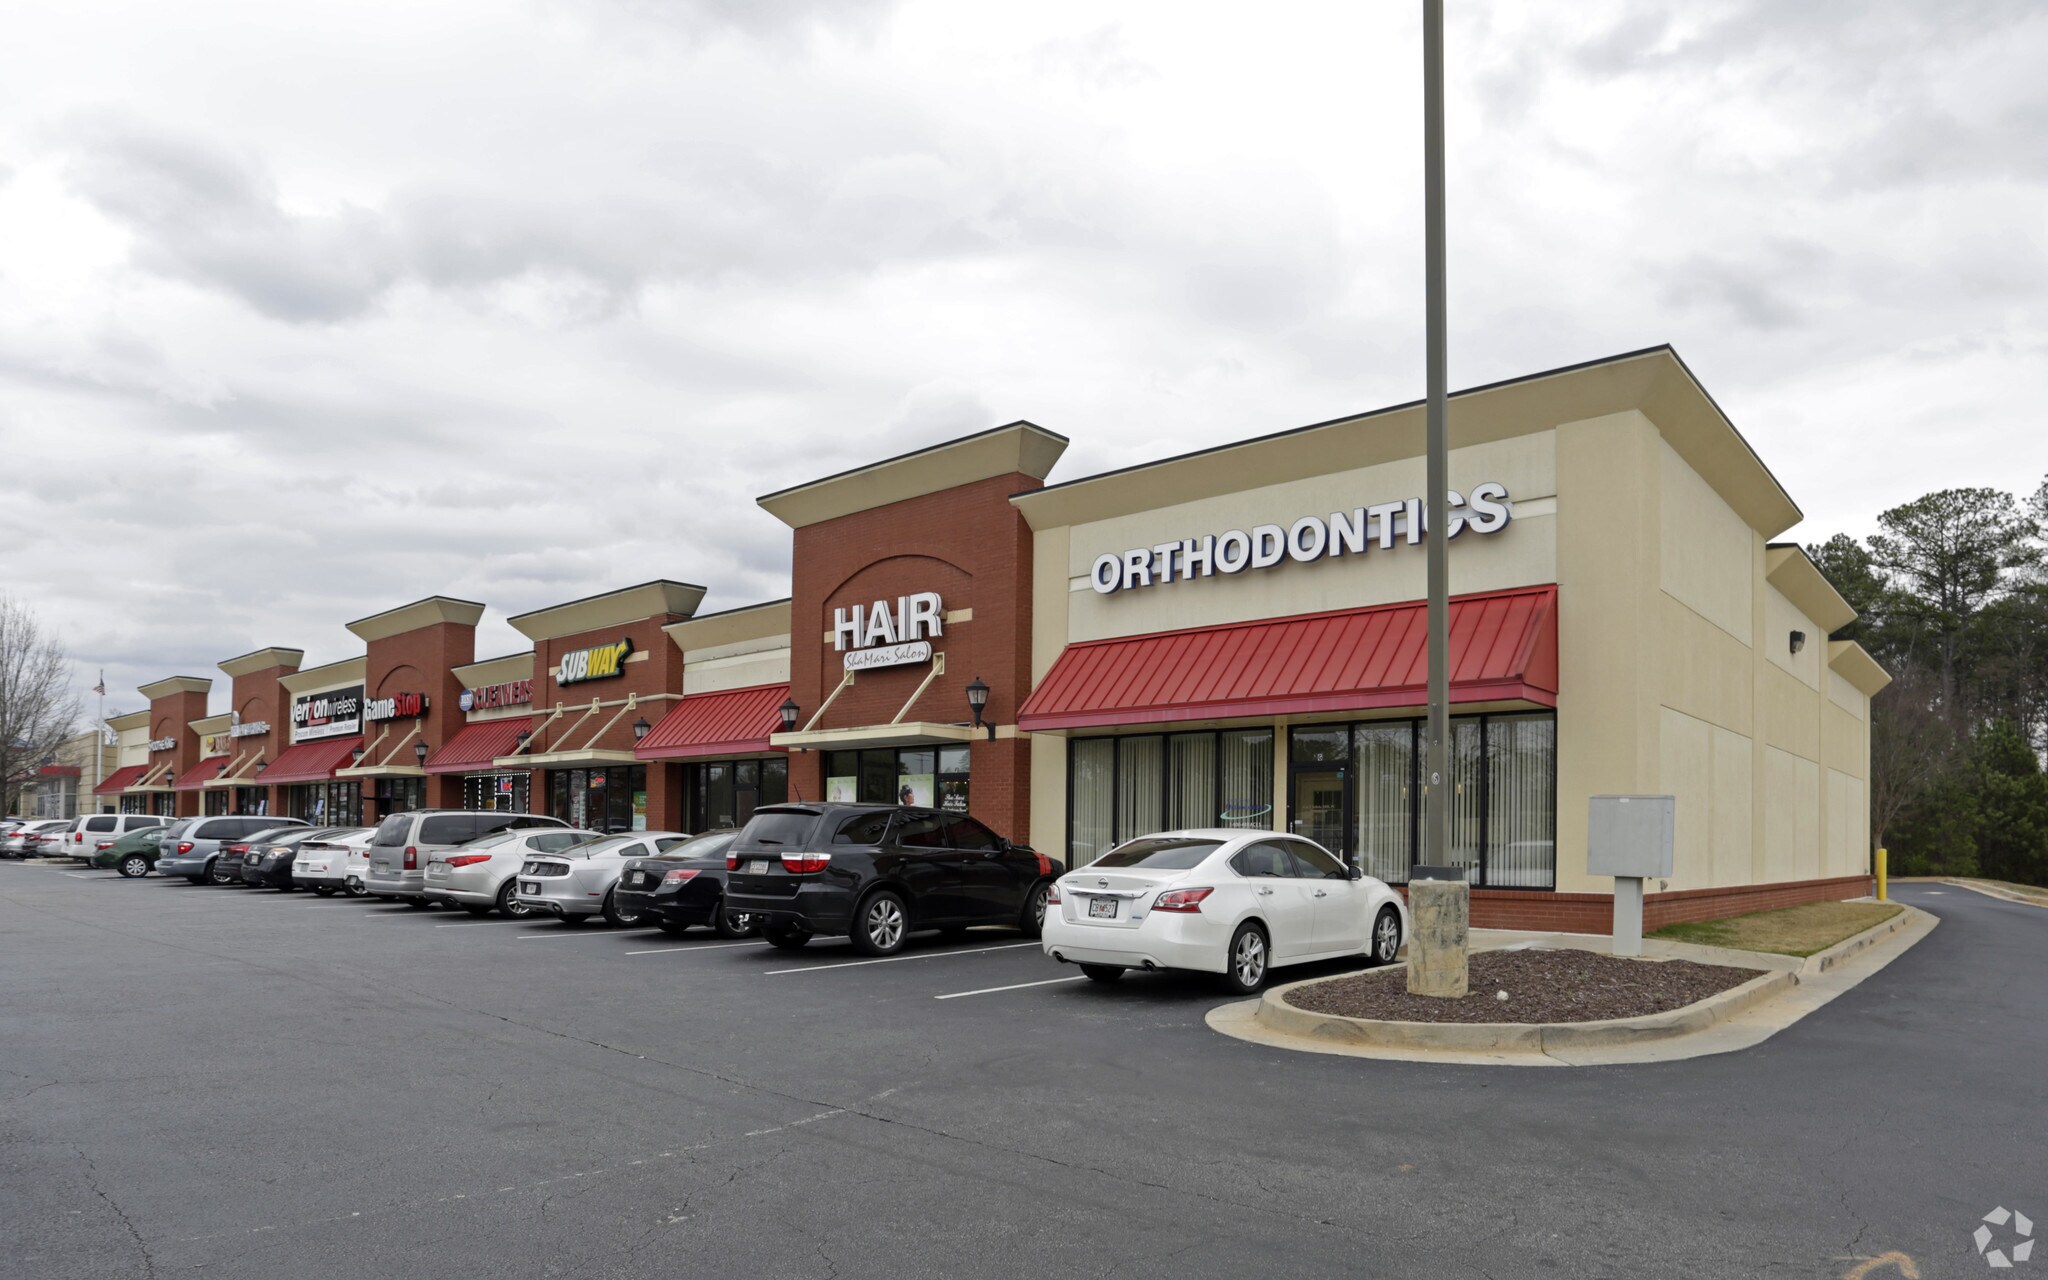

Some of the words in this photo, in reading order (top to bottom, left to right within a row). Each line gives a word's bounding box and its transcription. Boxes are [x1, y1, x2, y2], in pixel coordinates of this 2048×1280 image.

[834, 591, 942, 651] HAIR
[556, 640, 628, 682] SUBWAY
[894, 645, 926, 663] Salon
[364, 692, 421, 721] GameStop
[473, 678, 534, 710] CLEANERS
